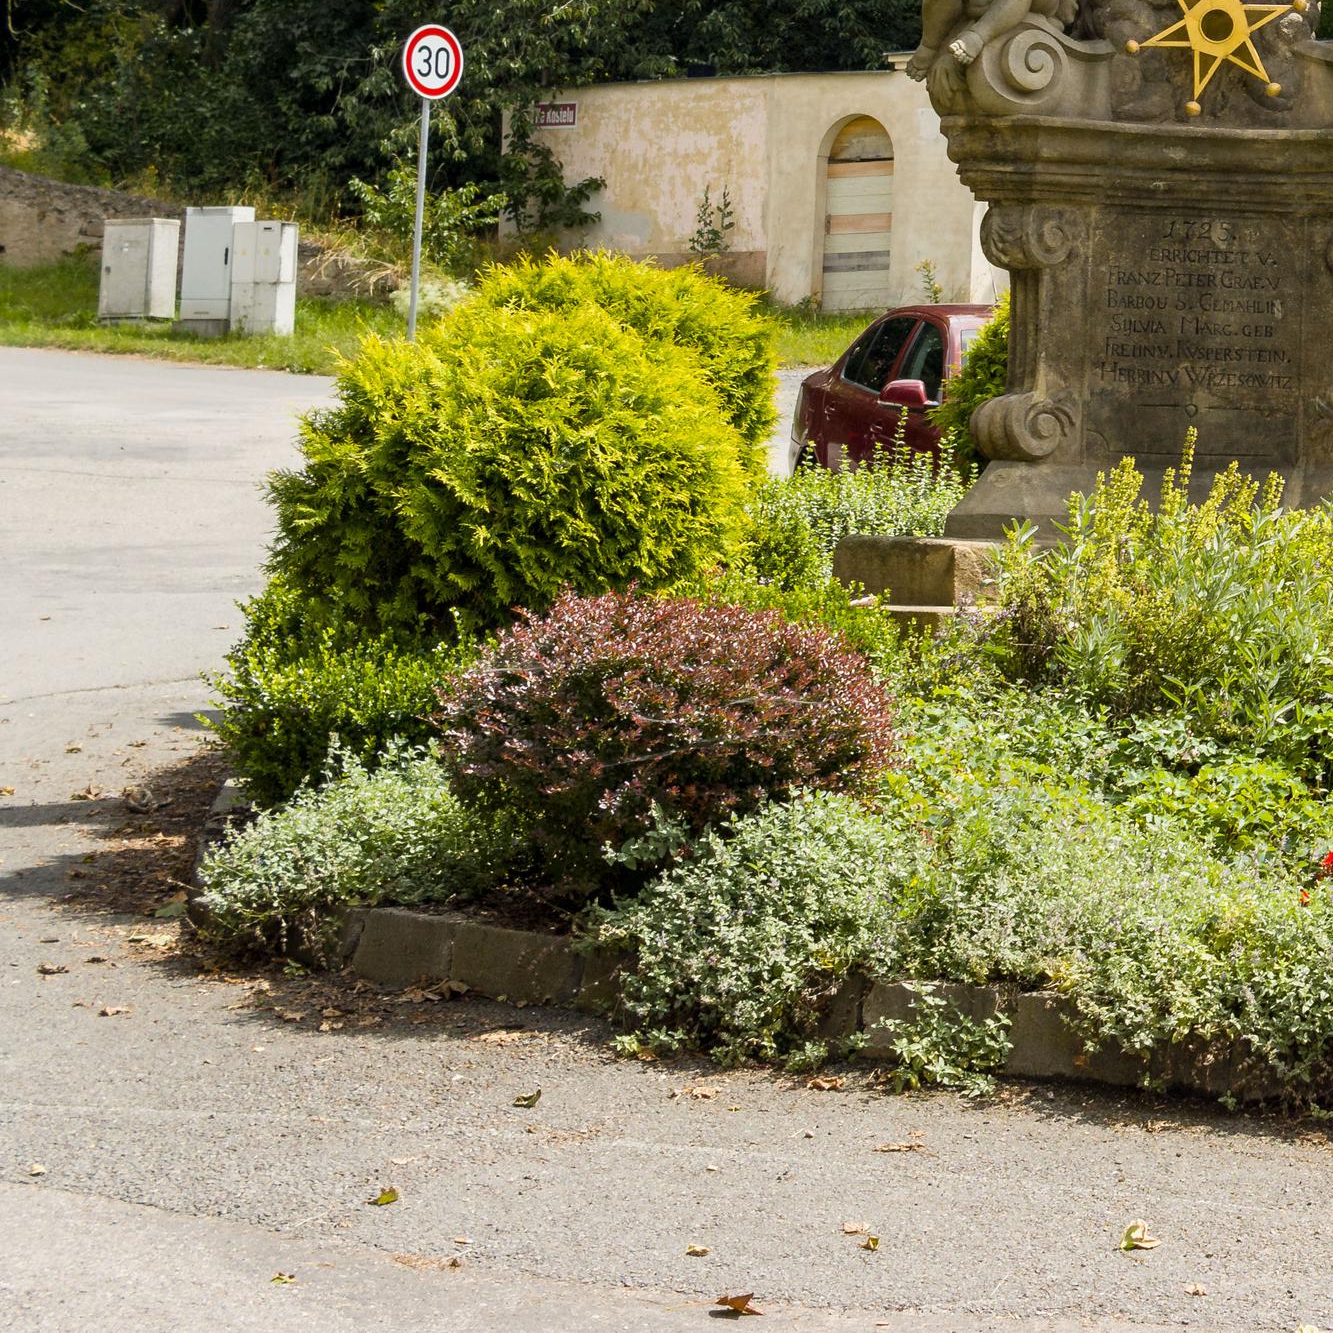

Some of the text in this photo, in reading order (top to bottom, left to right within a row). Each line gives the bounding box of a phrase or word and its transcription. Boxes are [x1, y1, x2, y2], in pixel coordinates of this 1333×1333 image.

[417, 45, 450, 79] 30
[1149, 248, 1248, 265] ERRICHTET
[1164, 267, 1217, 288] PETER
